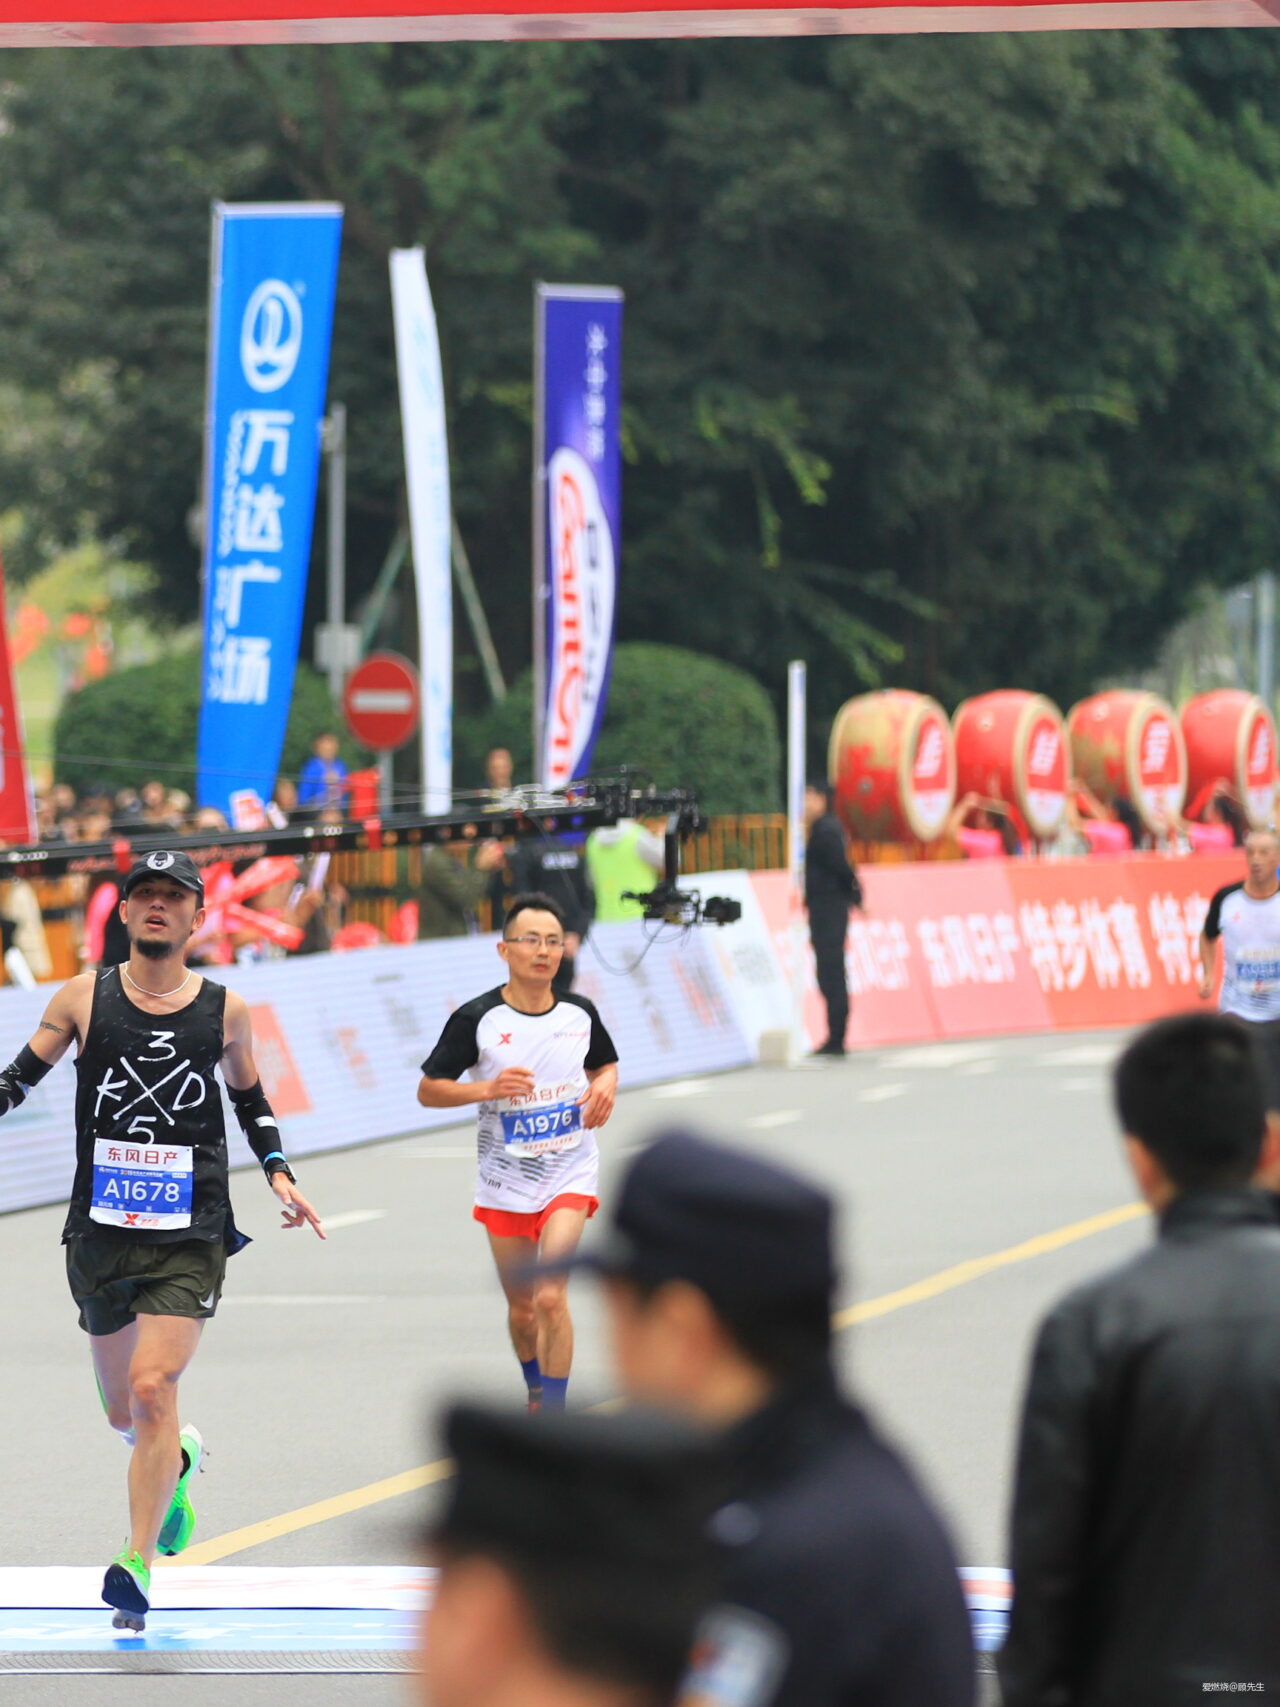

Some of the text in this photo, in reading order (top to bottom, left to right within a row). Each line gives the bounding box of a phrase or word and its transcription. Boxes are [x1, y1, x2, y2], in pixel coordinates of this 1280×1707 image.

[218, 408, 296, 706] 万达广场
[512, 1108, 573, 1137] A1976
[107, 1146, 179, 1165] 东风日产
[103, 1178, 180, 1203] A1678
